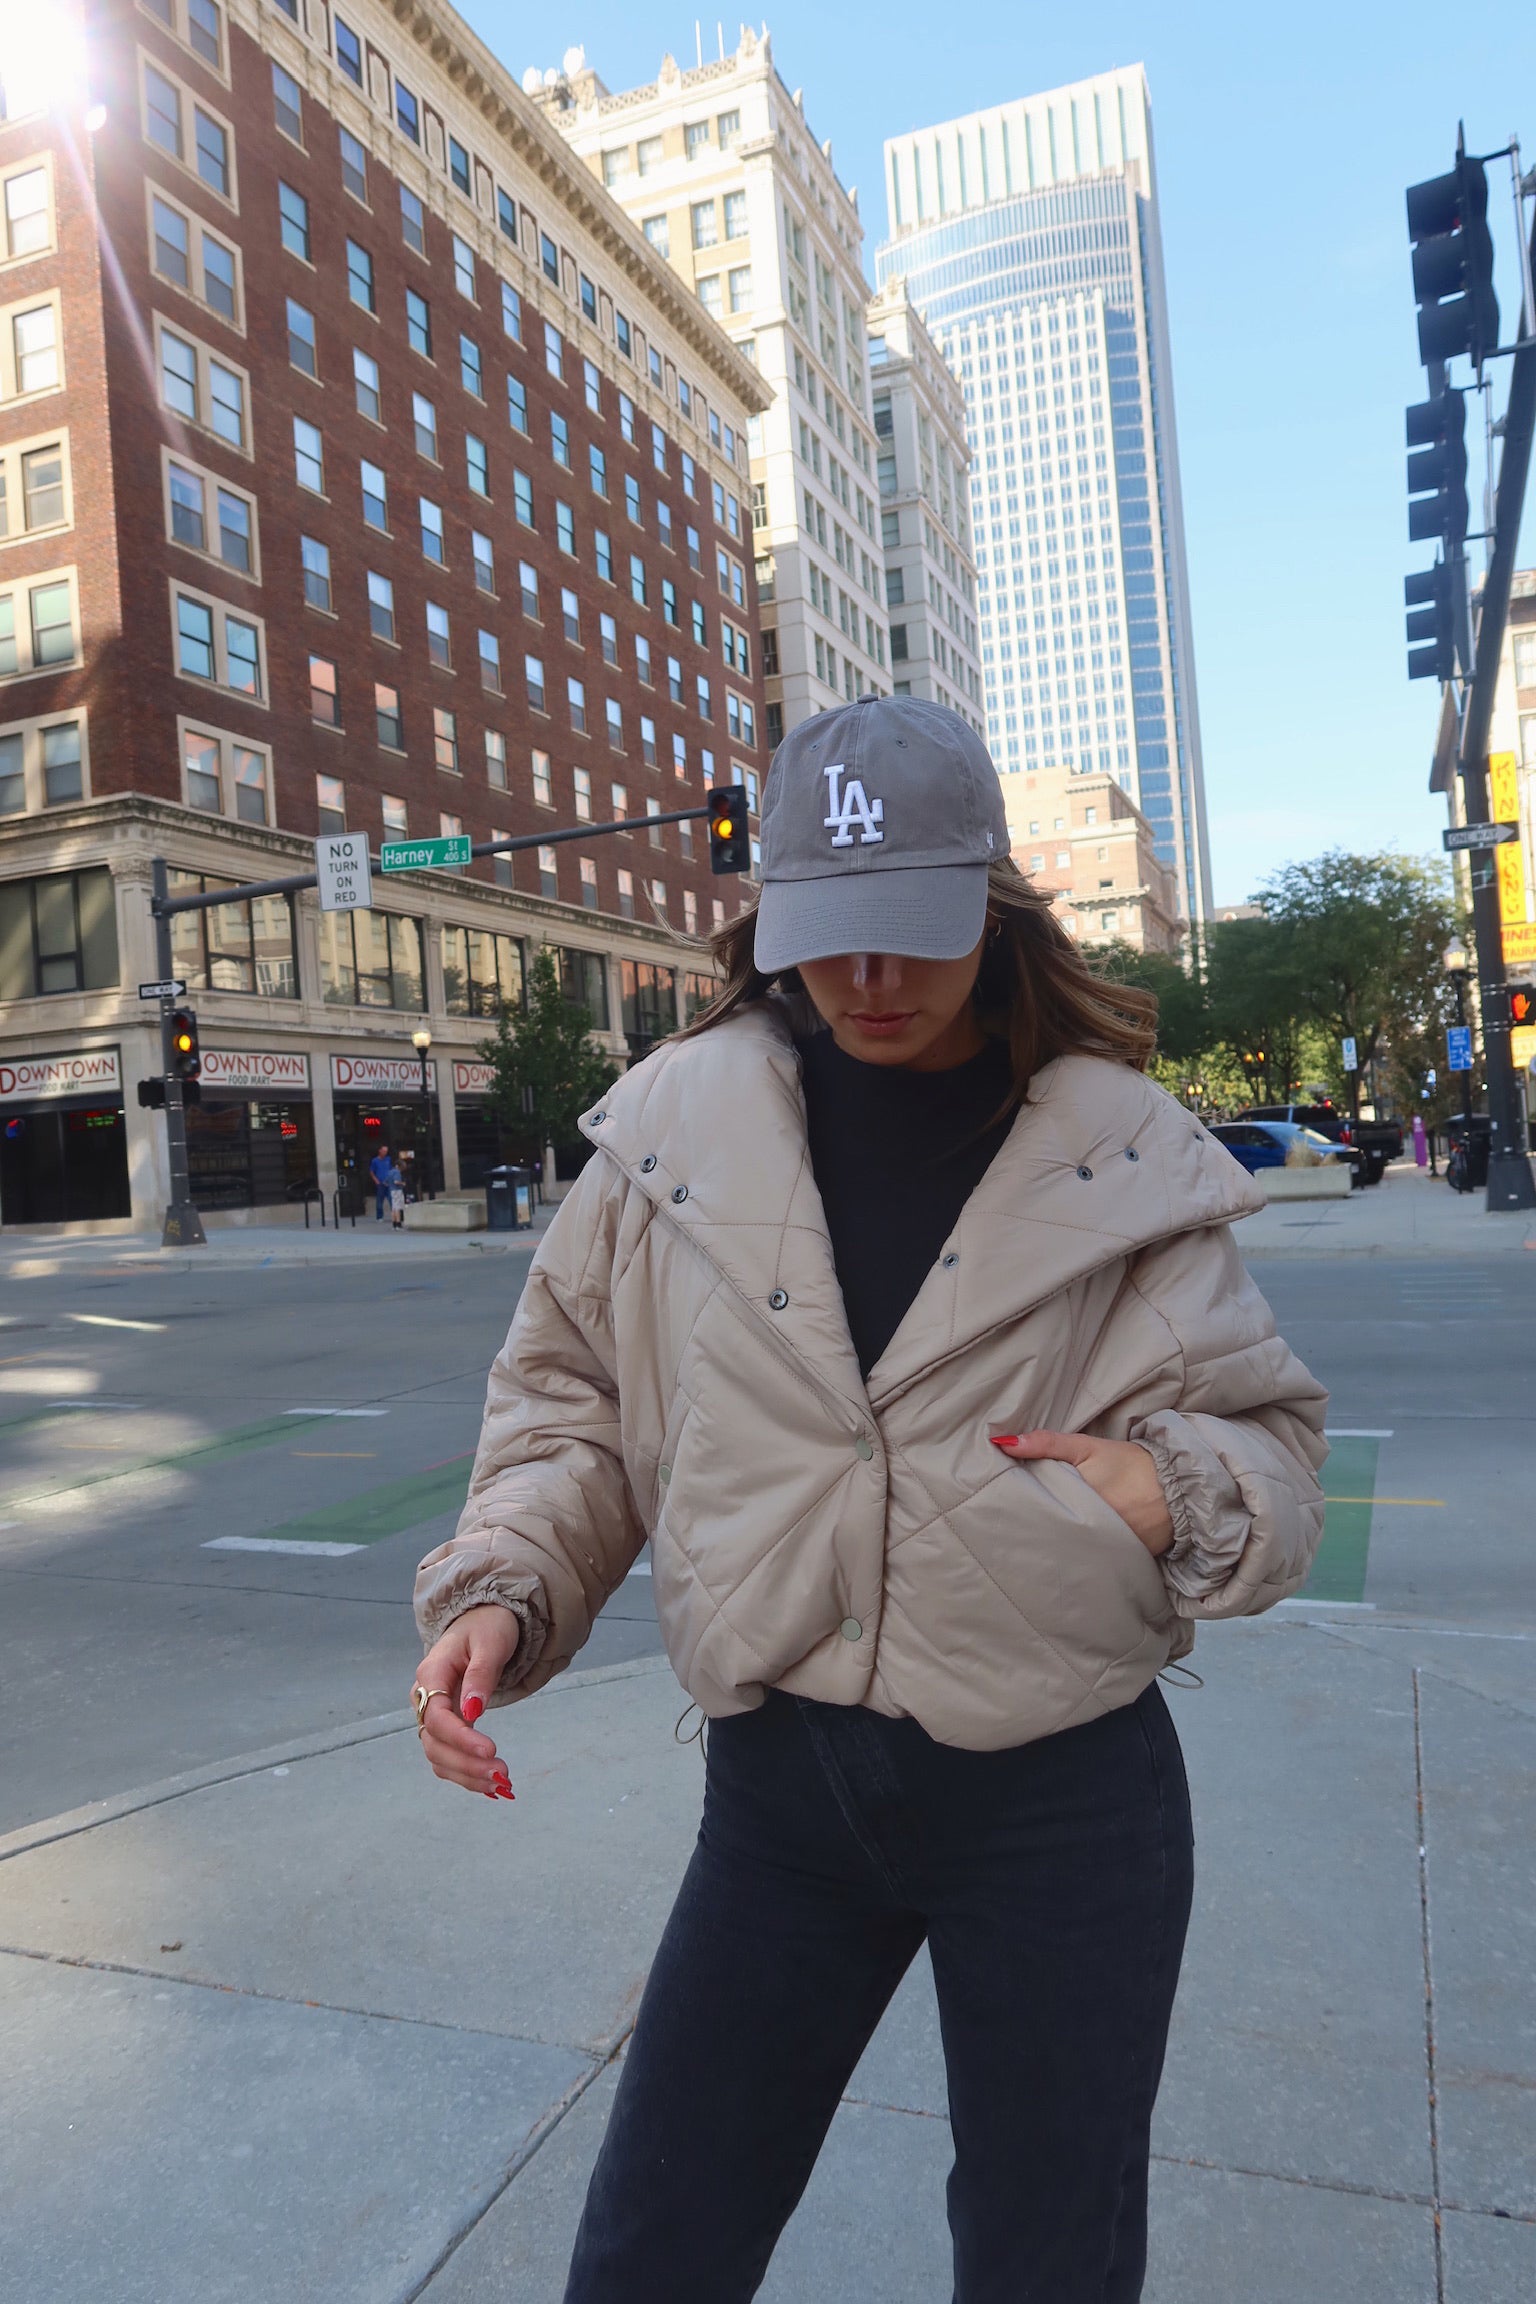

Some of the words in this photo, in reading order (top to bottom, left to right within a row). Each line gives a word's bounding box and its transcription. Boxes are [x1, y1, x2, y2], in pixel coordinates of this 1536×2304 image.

[1497, 760, 1514, 818] KIN
[823, 764, 884, 848] LA
[1450, 832, 1473, 843] ONE
[1476, 830, 1497, 840] WAY
[330, 842, 353, 858] NO
[448, 840, 458, 851] St
[385, 848, 434, 866] Harney
[443, 851, 459, 862] 400
[461, 850, 467, 861] S
[328, 861, 358, 873] TURN
[336, 876, 352, 888] ON
[334, 891, 357, 903] RED
[203, 1053, 304, 1076] OWNTOWN
[0, 1057, 115, 1094] DOWNTOWN
[228, 1074, 248, 1085] FOOD
[250, 1075, 270, 1085] MART
[456, 1063, 498, 1089] DOWN
[372, 1079, 388, 1089] FOOD
[389, 1080, 405, 1090] MART
